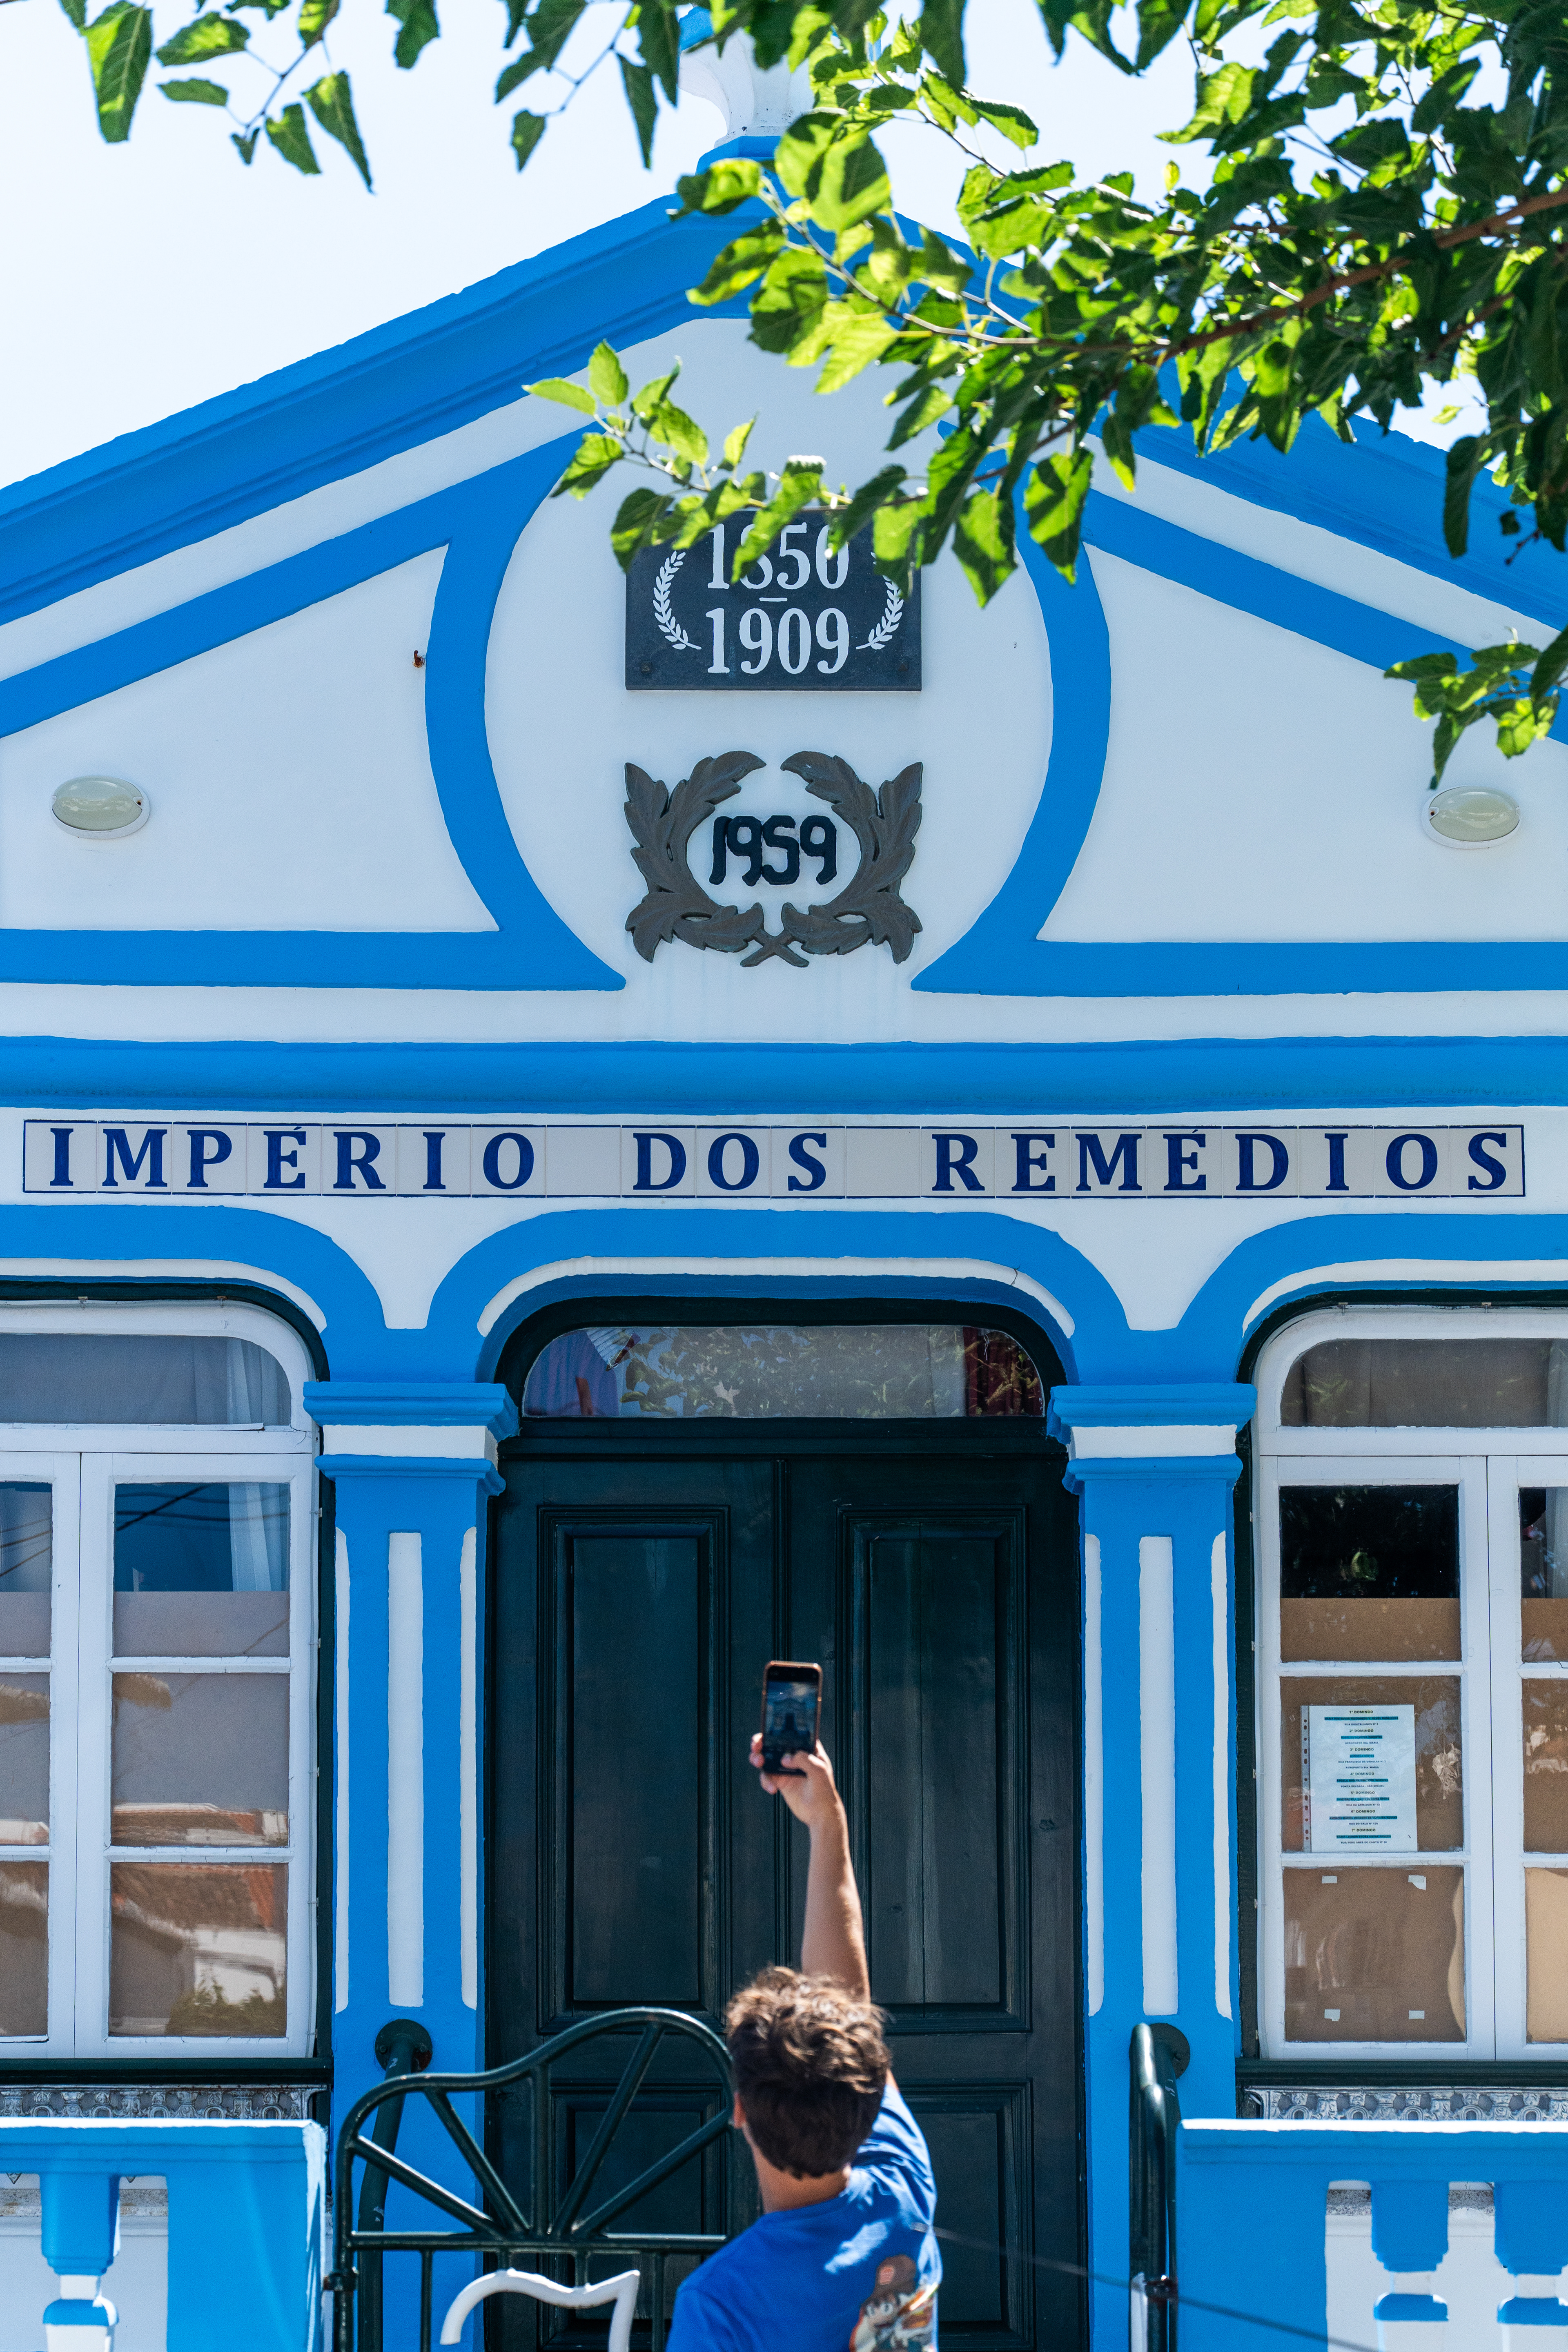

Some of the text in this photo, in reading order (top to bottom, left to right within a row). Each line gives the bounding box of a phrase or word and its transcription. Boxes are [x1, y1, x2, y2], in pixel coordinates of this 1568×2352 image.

[706, 608, 849, 674] 1909
[709, 815, 837, 886] 1959
[50, 1126, 1508, 1192] IMPÉRIO DOS REMÉDIOS
